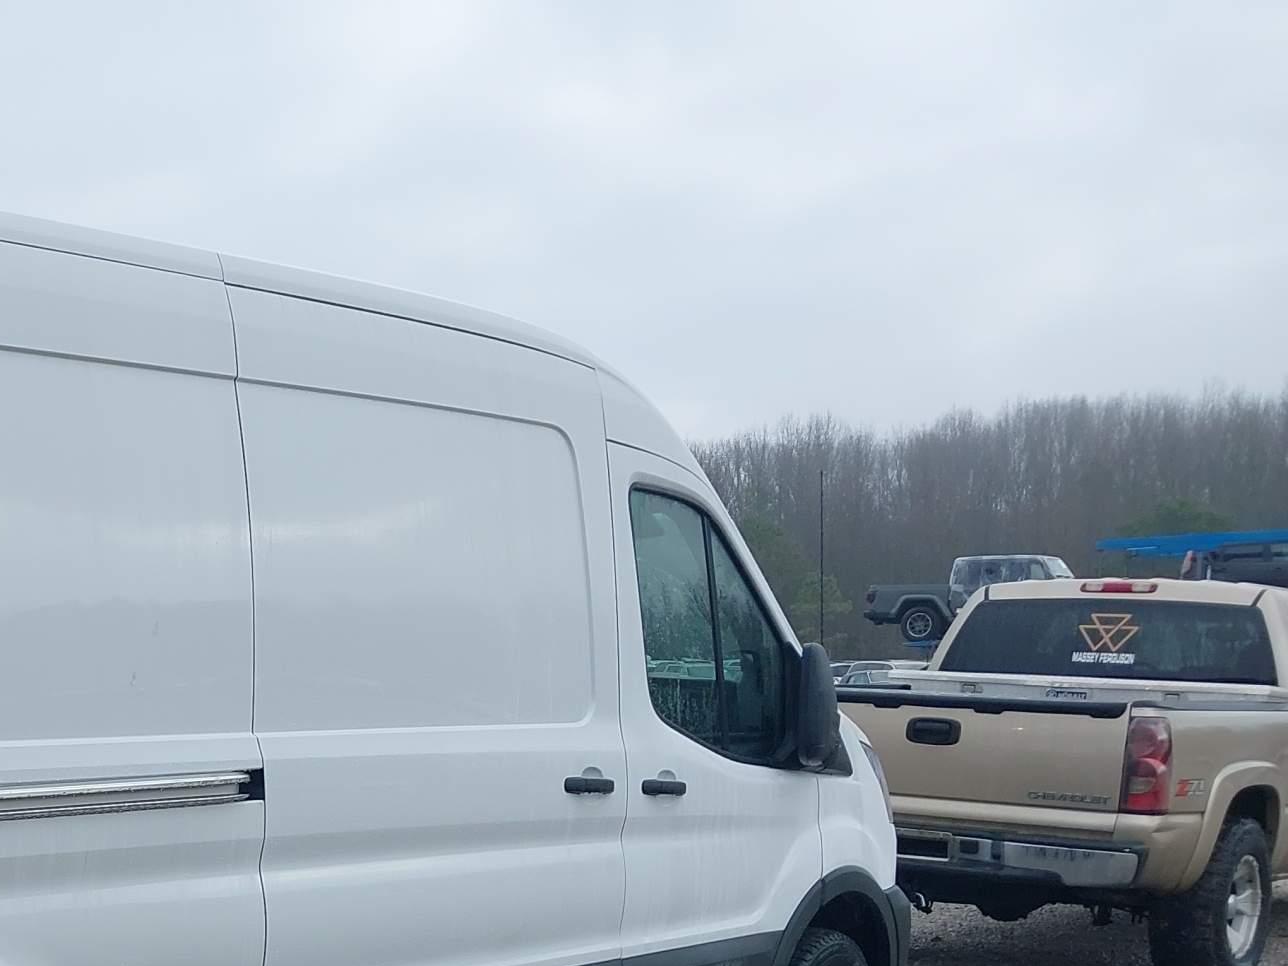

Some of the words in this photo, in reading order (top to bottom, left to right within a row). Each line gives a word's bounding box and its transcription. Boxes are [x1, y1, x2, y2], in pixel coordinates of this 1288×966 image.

[1071, 651, 1100, 663] MASSEY
[1098, 652, 1136, 665] FERGUSON
[1027, 791, 1112, 805] CHEVROLET
